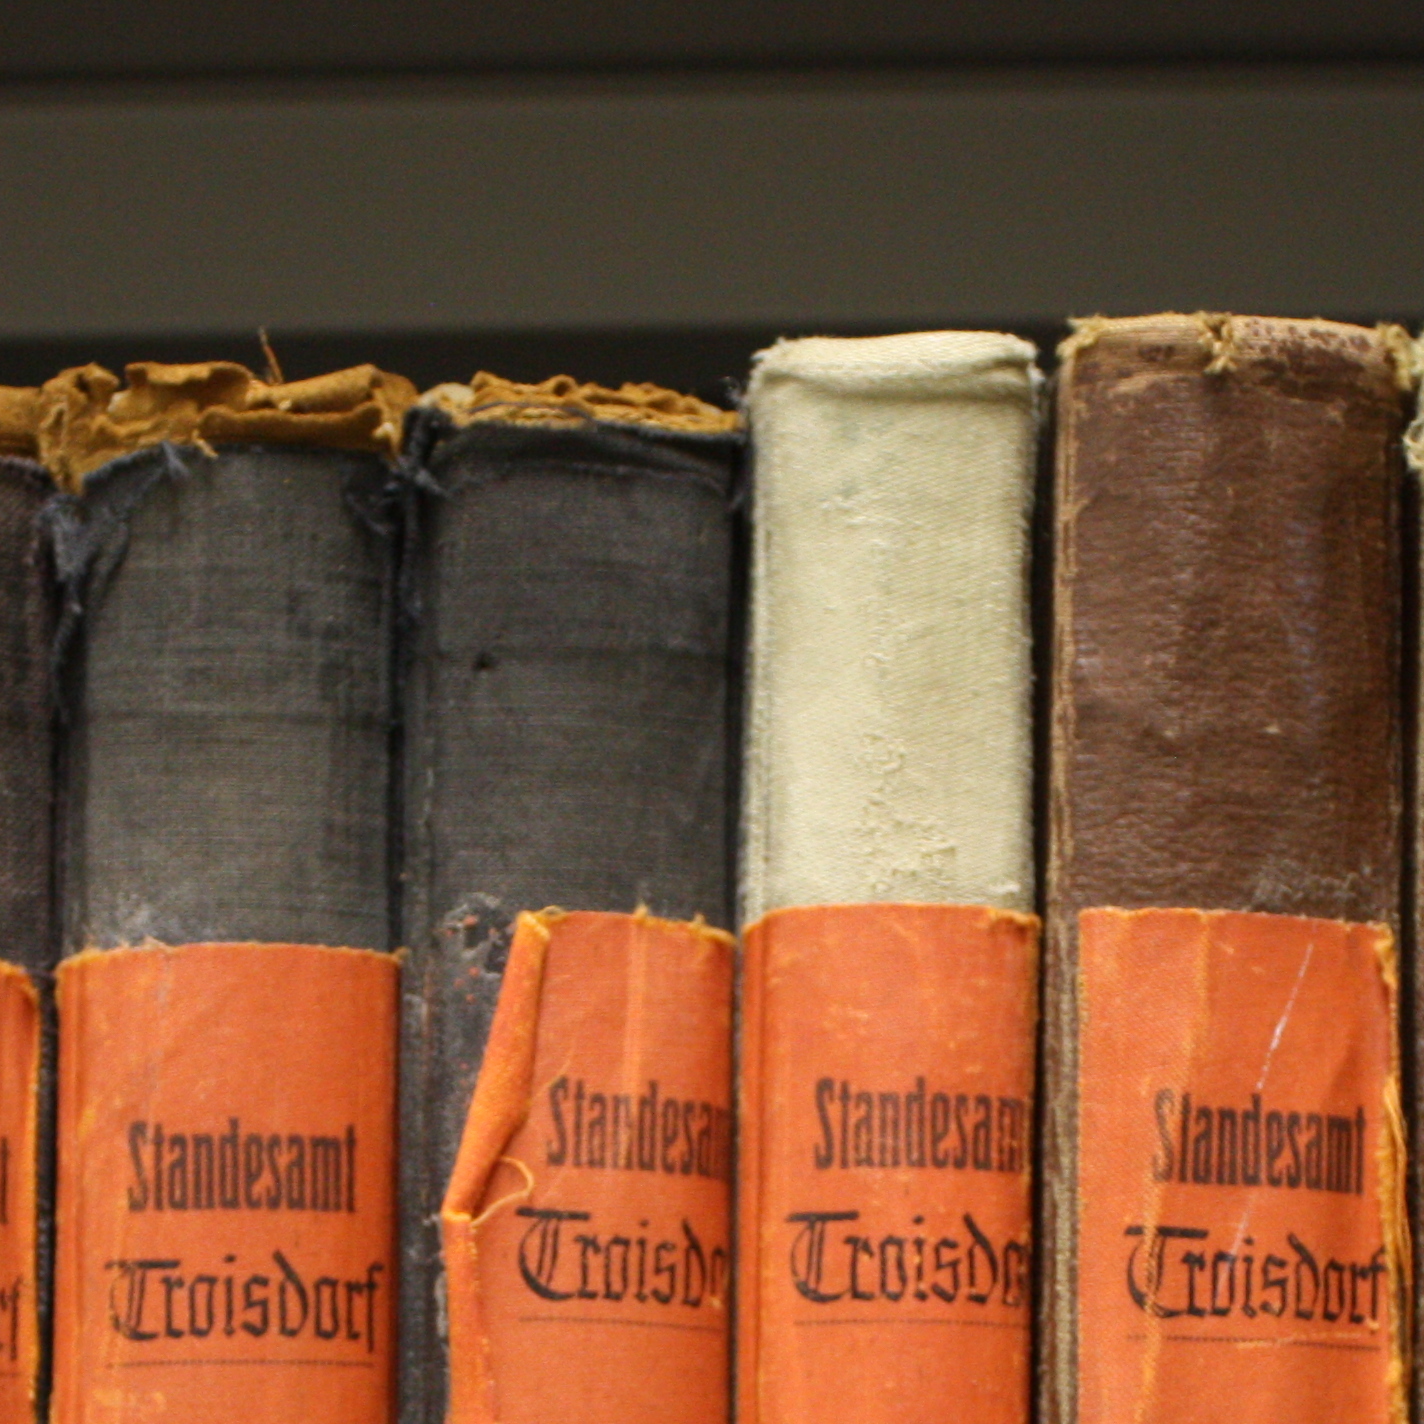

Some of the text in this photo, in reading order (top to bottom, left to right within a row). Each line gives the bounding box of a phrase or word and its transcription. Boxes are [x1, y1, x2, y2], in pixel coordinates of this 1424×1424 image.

[127, 1117, 357, 1215] Standesamt
[1153, 1088, 1366, 1195] Standesamt
[105, 1250, 384, 1354] Troisdorf
[785, 1210, 1030, 1308] Troisdo
[1125, 1225, 1387, 1334] Troisdorf
